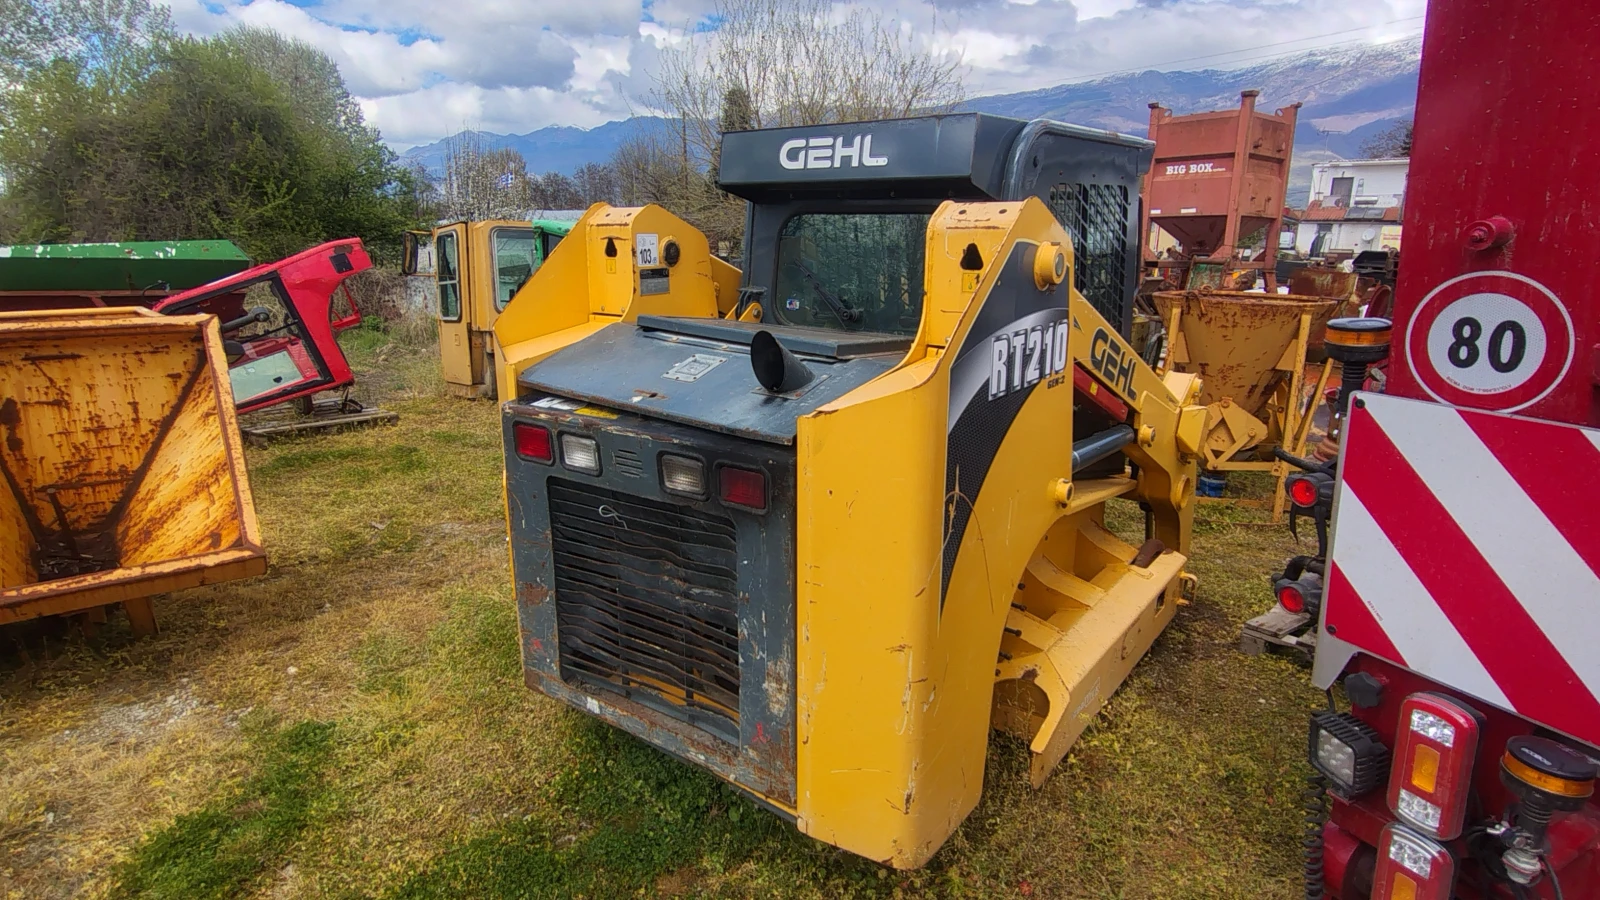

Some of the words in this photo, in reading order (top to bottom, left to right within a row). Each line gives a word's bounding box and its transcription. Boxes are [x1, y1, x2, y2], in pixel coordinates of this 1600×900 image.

[779, 133, 888, 170] GEHL
[1166, 165, 1186, 175] BIG
[1189, 163, 1213, 174] BOX
[640, 248, 652, 264] 103
[988, 319, 1069, 401] RT210
[1090, 326, 1137, 402] GEHL
[1447, 316, 1527, 374] 80
